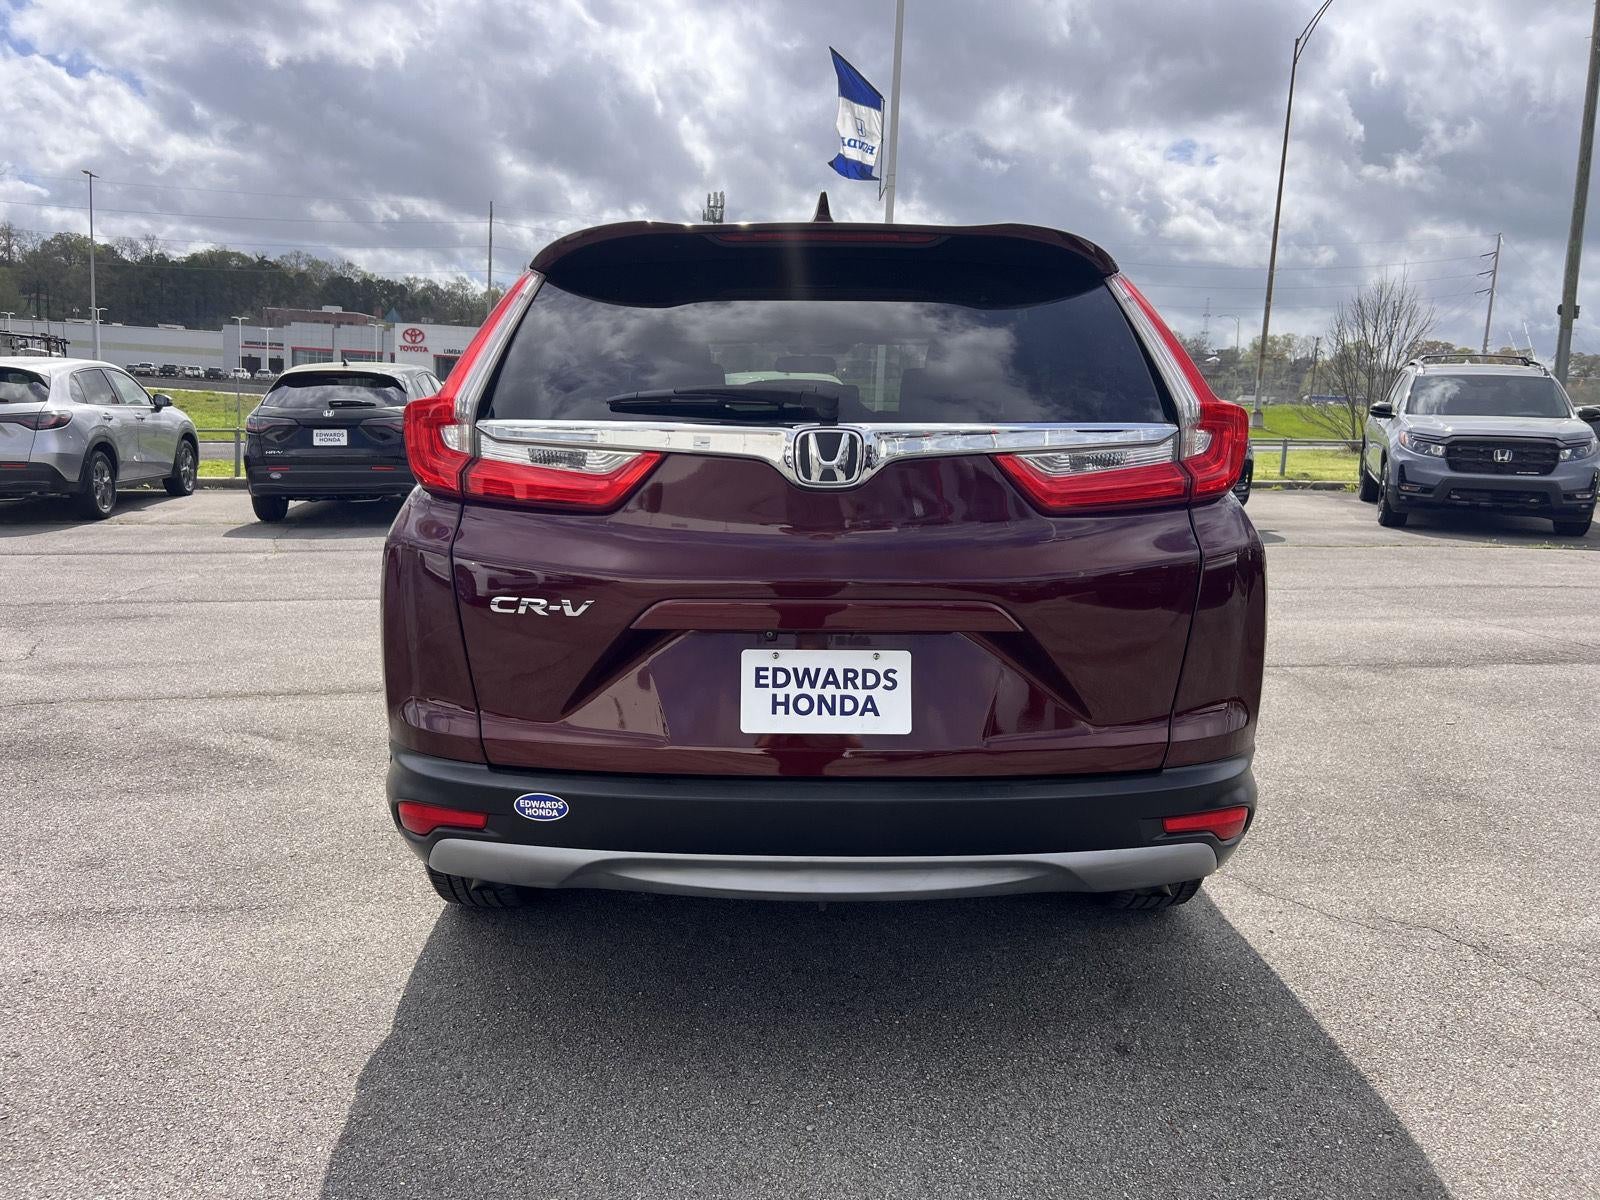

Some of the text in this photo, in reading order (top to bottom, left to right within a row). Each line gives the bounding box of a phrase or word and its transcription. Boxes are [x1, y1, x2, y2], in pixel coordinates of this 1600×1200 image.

[398, 345, 429, 353] TOYOTA
[490, 596, 595, 617] CR-V
[754, 666, 898, 691] EDWARDS
[771, 693, 881, 717] HONDA
[519, 799, 564, 809] EDWARDS
[525, 807, 559, 817] HONDA
